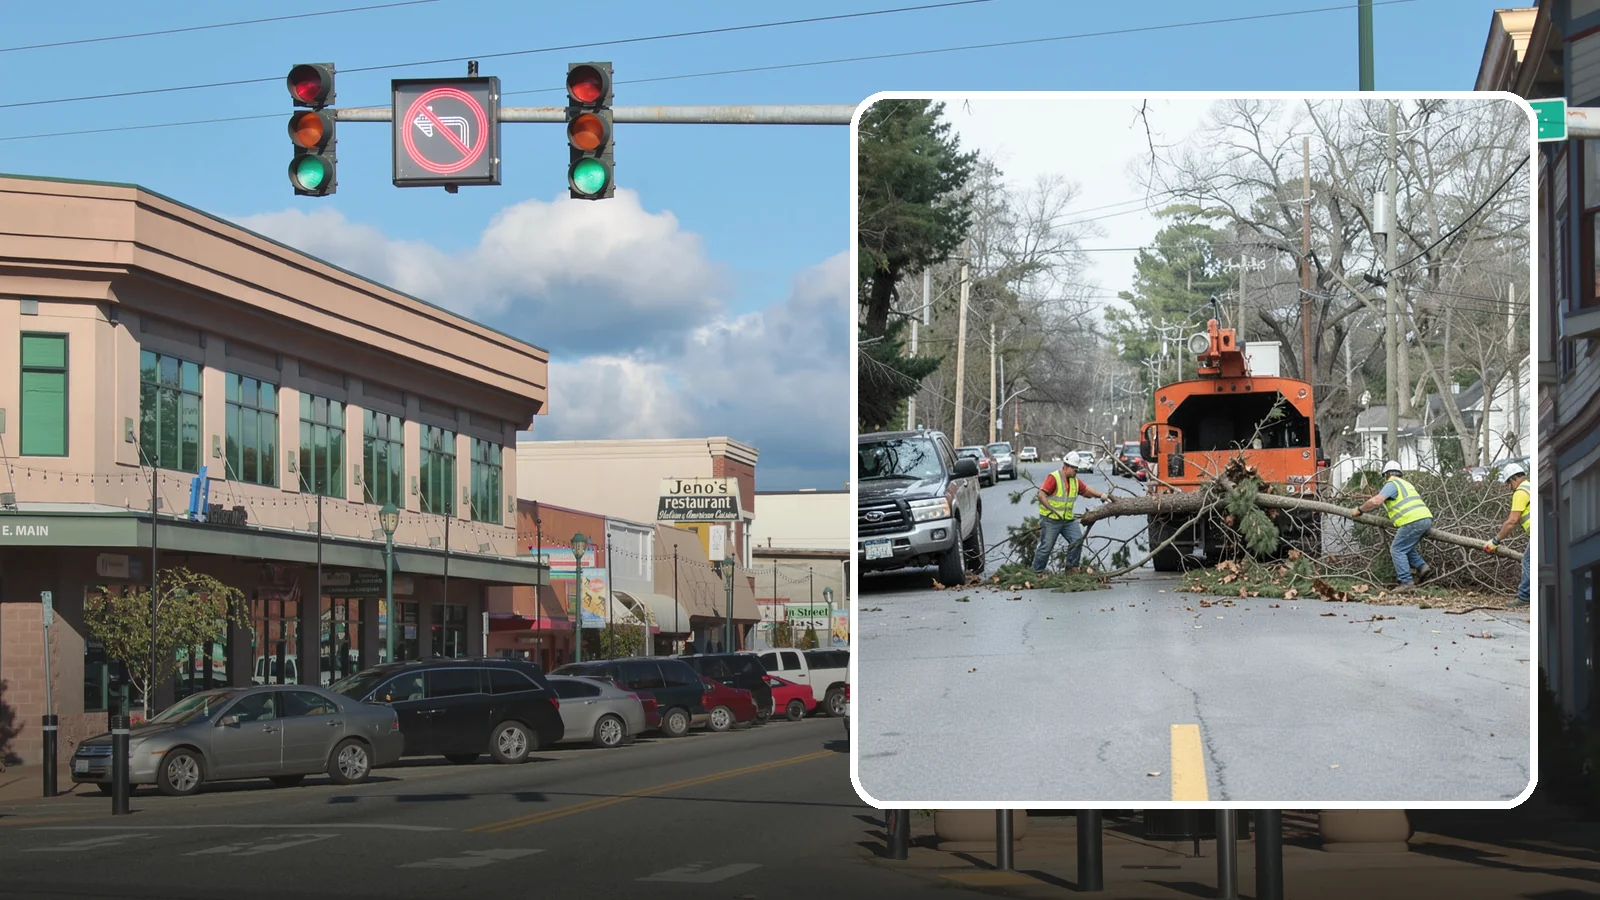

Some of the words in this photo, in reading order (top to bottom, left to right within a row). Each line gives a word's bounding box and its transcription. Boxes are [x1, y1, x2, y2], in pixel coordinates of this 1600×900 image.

[669, 479, 728, 495] Jeno's
[665, 496, 731, 509] restaurant
[658, 509, 681, 519] Italian
[686, 509, 714, 519] American
[714, 509, 737, 519] Cuisine
[2, 525, 13, 536] E.
[15, 525, 49, 536] MAIN
[797, 607, 828, 617] Street
